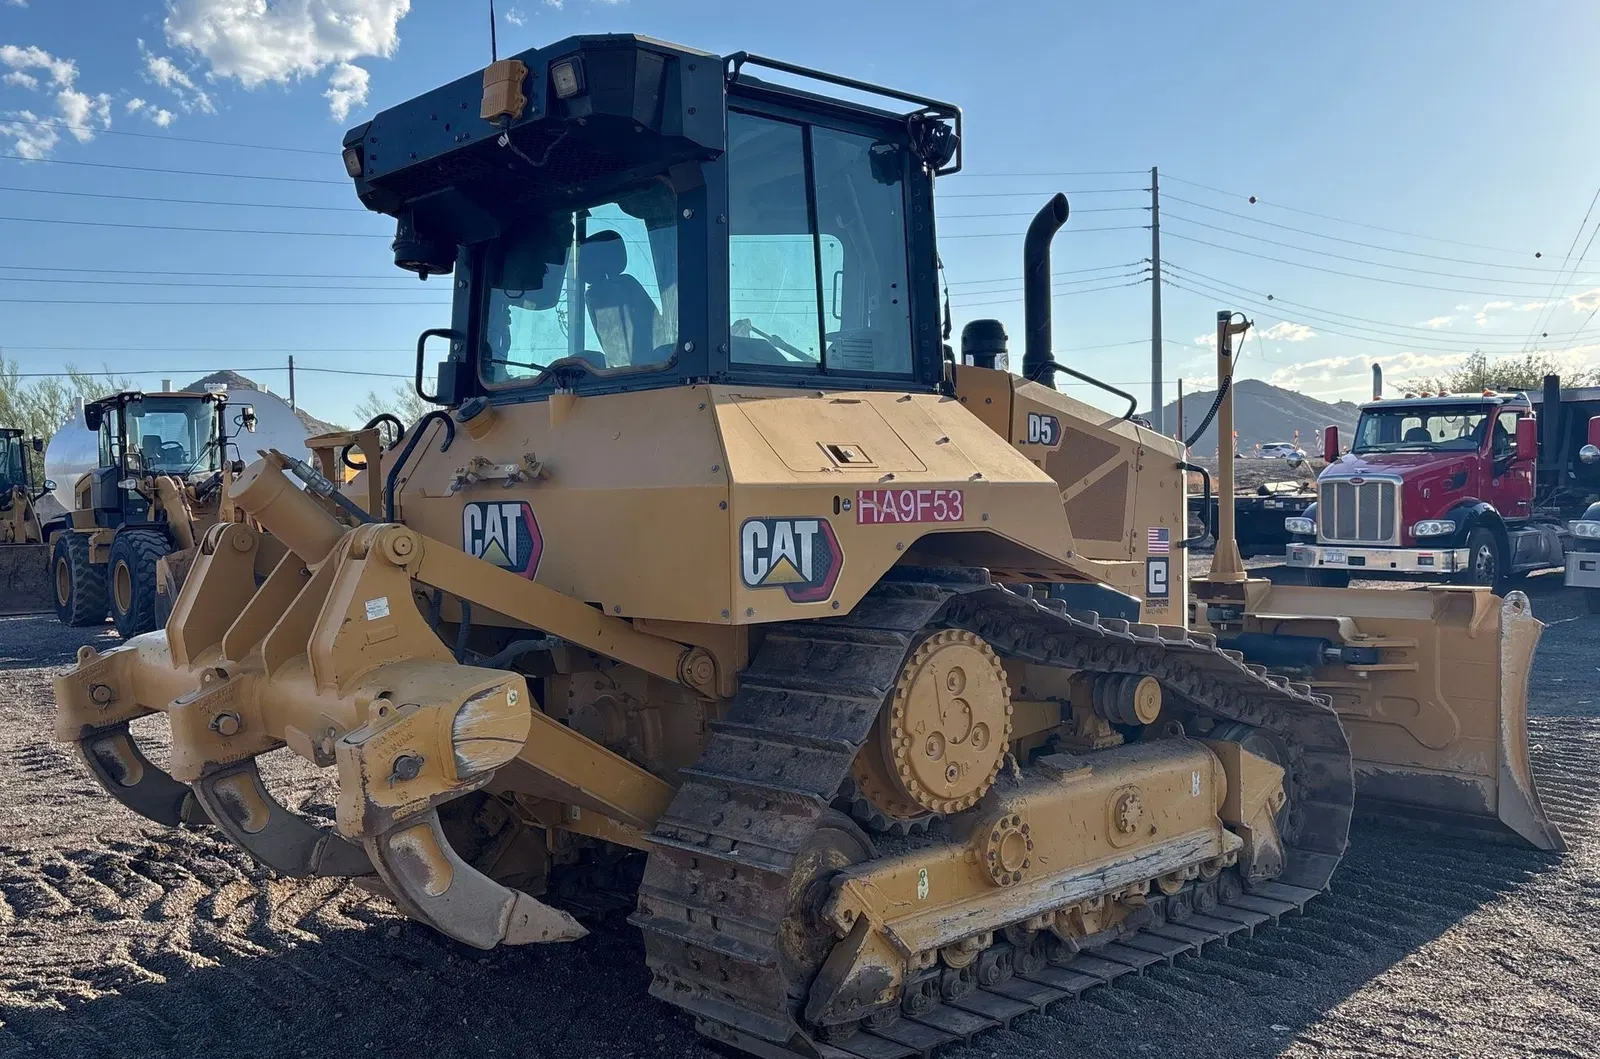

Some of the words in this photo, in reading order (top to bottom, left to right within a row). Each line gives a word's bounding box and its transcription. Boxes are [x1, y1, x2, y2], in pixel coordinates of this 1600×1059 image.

[1029, 414, 1052, 444] D5
[858, 490, 963, 523] HA9F53
[463, 503, 522, 567] CAT
[742, 520, 819, 585] CAT
